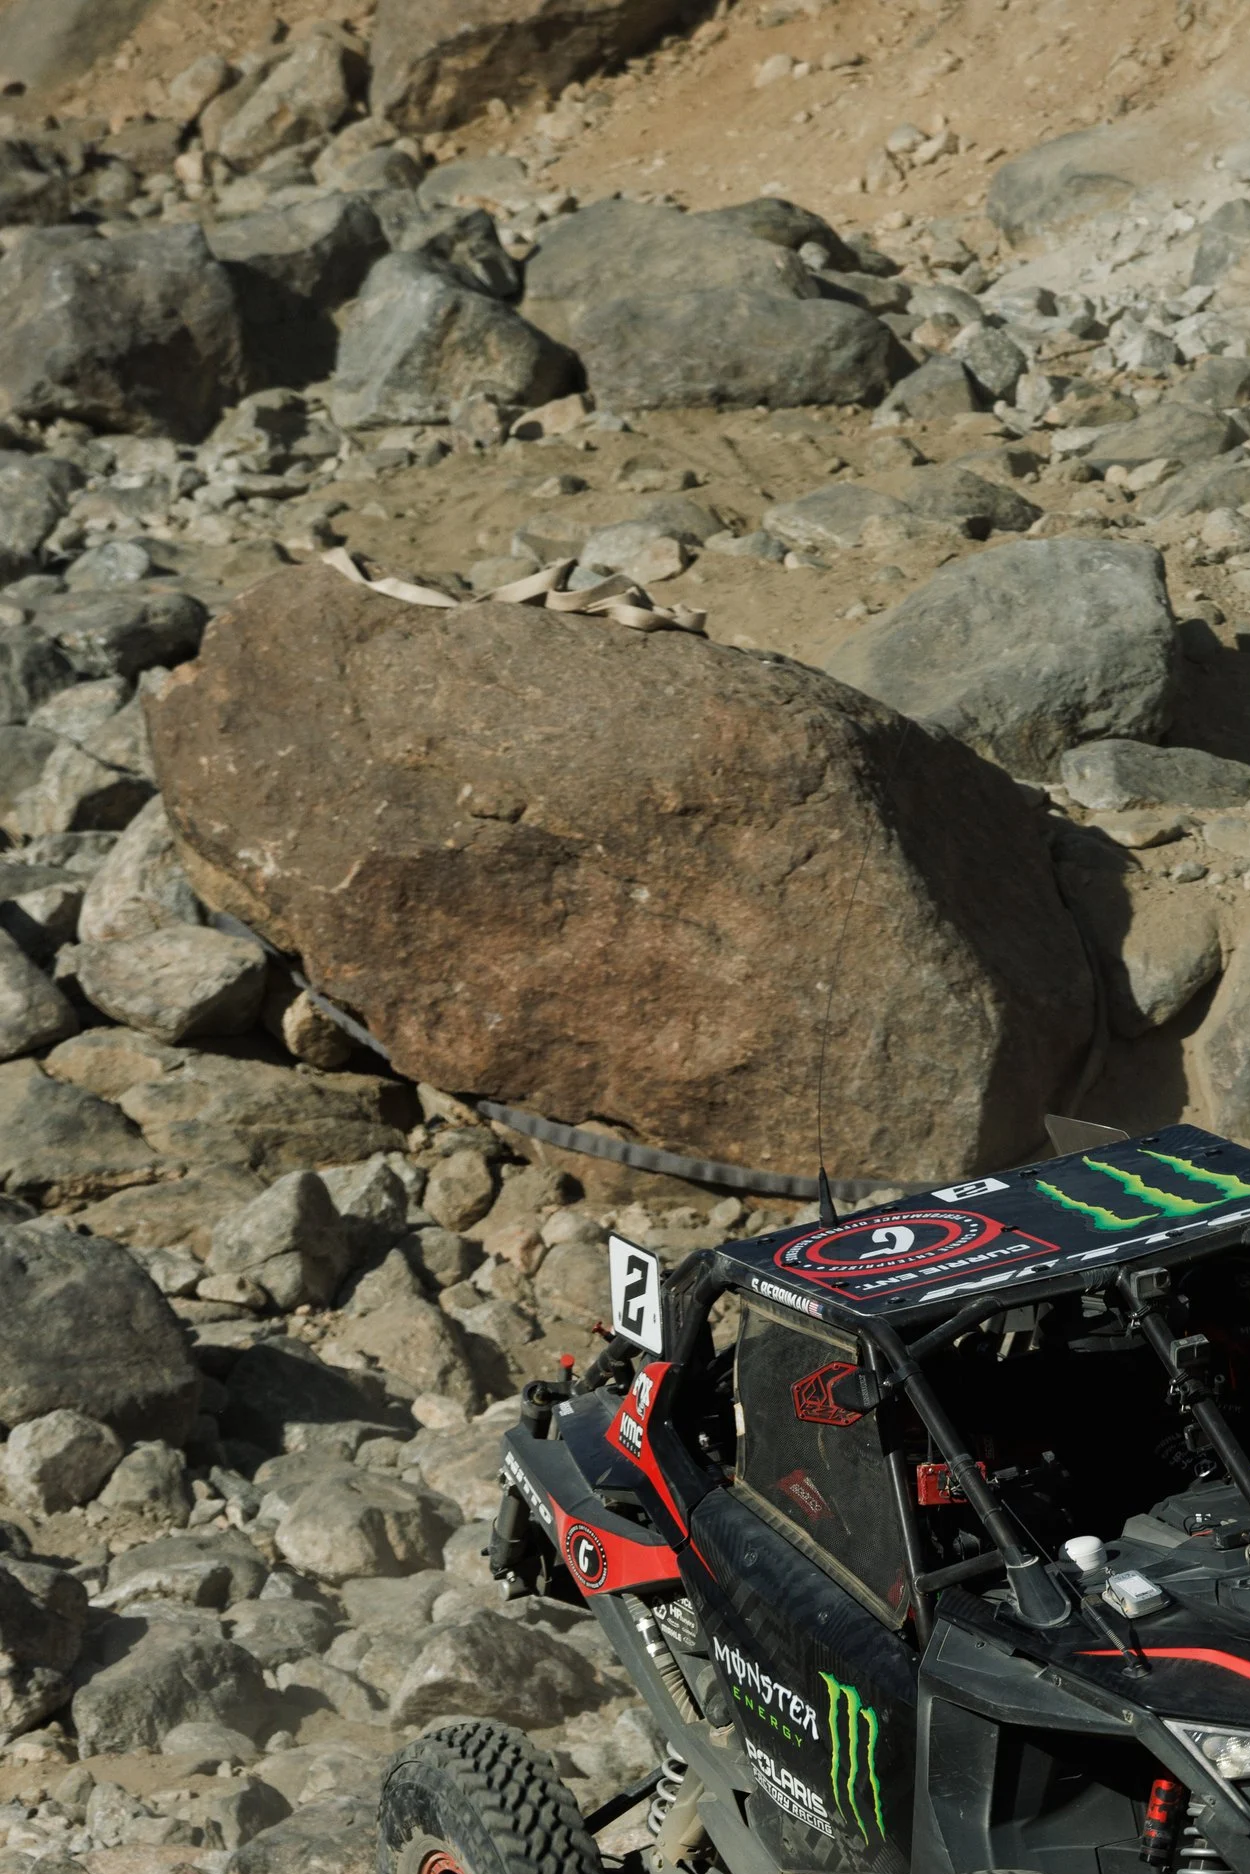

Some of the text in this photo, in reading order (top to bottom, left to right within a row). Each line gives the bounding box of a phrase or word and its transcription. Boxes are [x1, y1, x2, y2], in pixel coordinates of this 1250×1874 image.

[953, 1182, 988, 1200] 2
[621, 1254, 650, 1337] 2
[855, 1243, 1031, 1292] CURRIE ENT.
[620, 1411, 644, 1449] KMC
[504, 1451, 552, 1524] NITTO
[713, 1636, 820, 1741] MONSTER
[732, 1685, 803, 1748] ENERGY
[745, 1737, 829, 1818] POLARIS
[753, 1769, 833, 1835] FACTORY RACING
